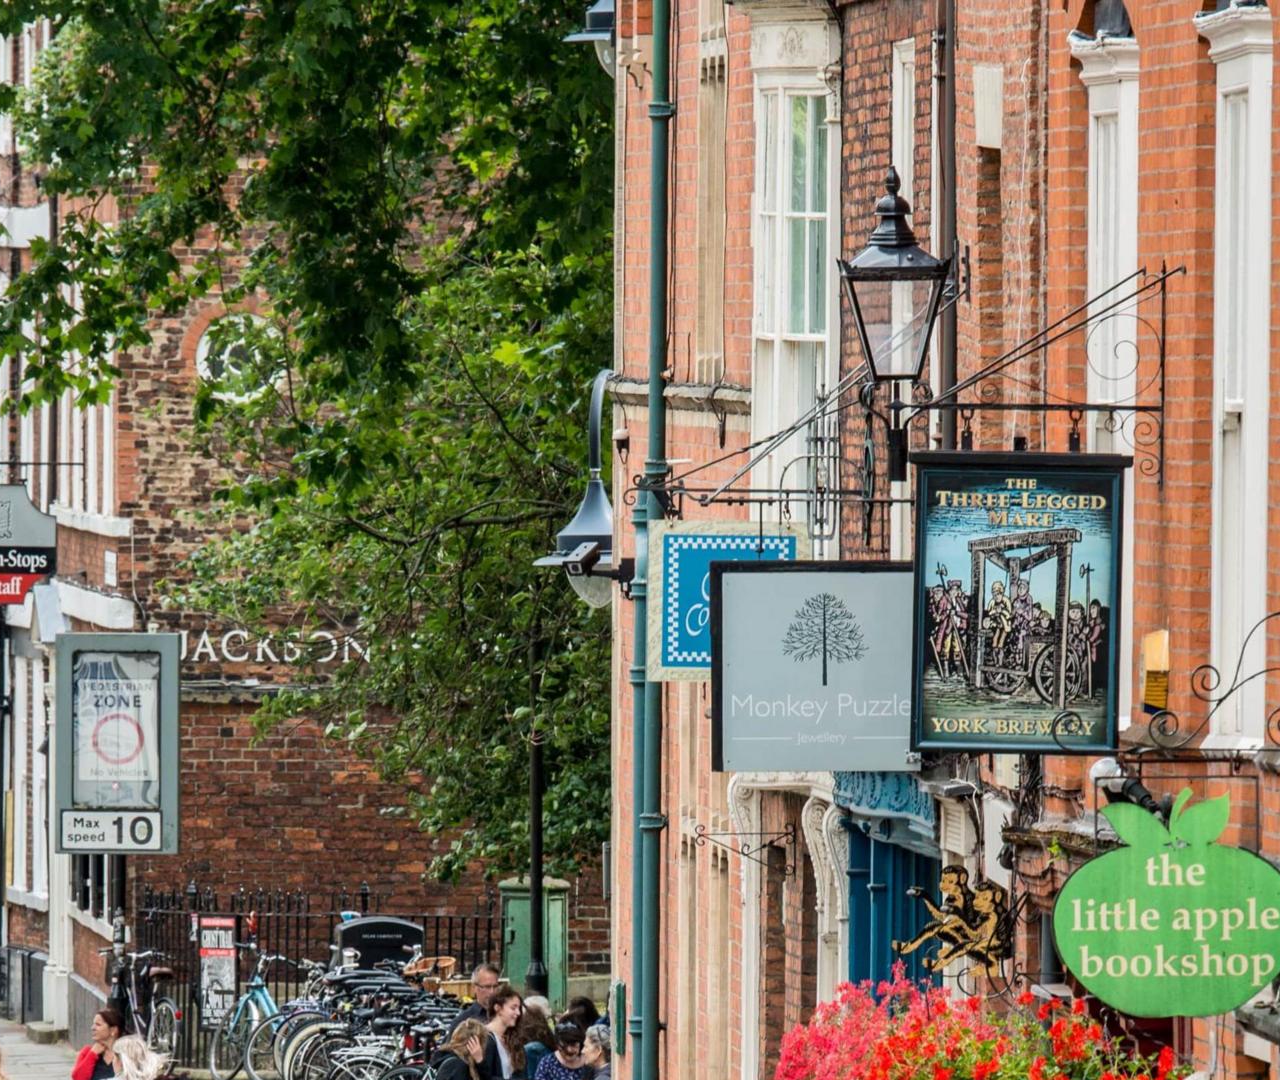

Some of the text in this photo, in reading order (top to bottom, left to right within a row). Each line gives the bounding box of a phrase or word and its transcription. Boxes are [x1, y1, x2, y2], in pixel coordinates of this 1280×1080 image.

[1005, 478, 1037, 490] THE
[936, 490, 1108, 510] THREE-LEGGED
[988, 511, 1056, 527] MARE
[94, 694, 142, 708] ZONE
[731, 693, 911, 724] Monkey Puzzle
[932, 717, 988, 734] YORK
[797, 731, 848, 746] Jewellery
[91, 767, 104, 776] No
[73, 817, 100, 828] Max
[112, 816, 153, 845] 10
[67, 830, 105, 843] speed
[1145, 853, 1206, 886] the
[1071, 897, 1280, 941] little apple
[1079, 944, 1276, 987] bookshop
